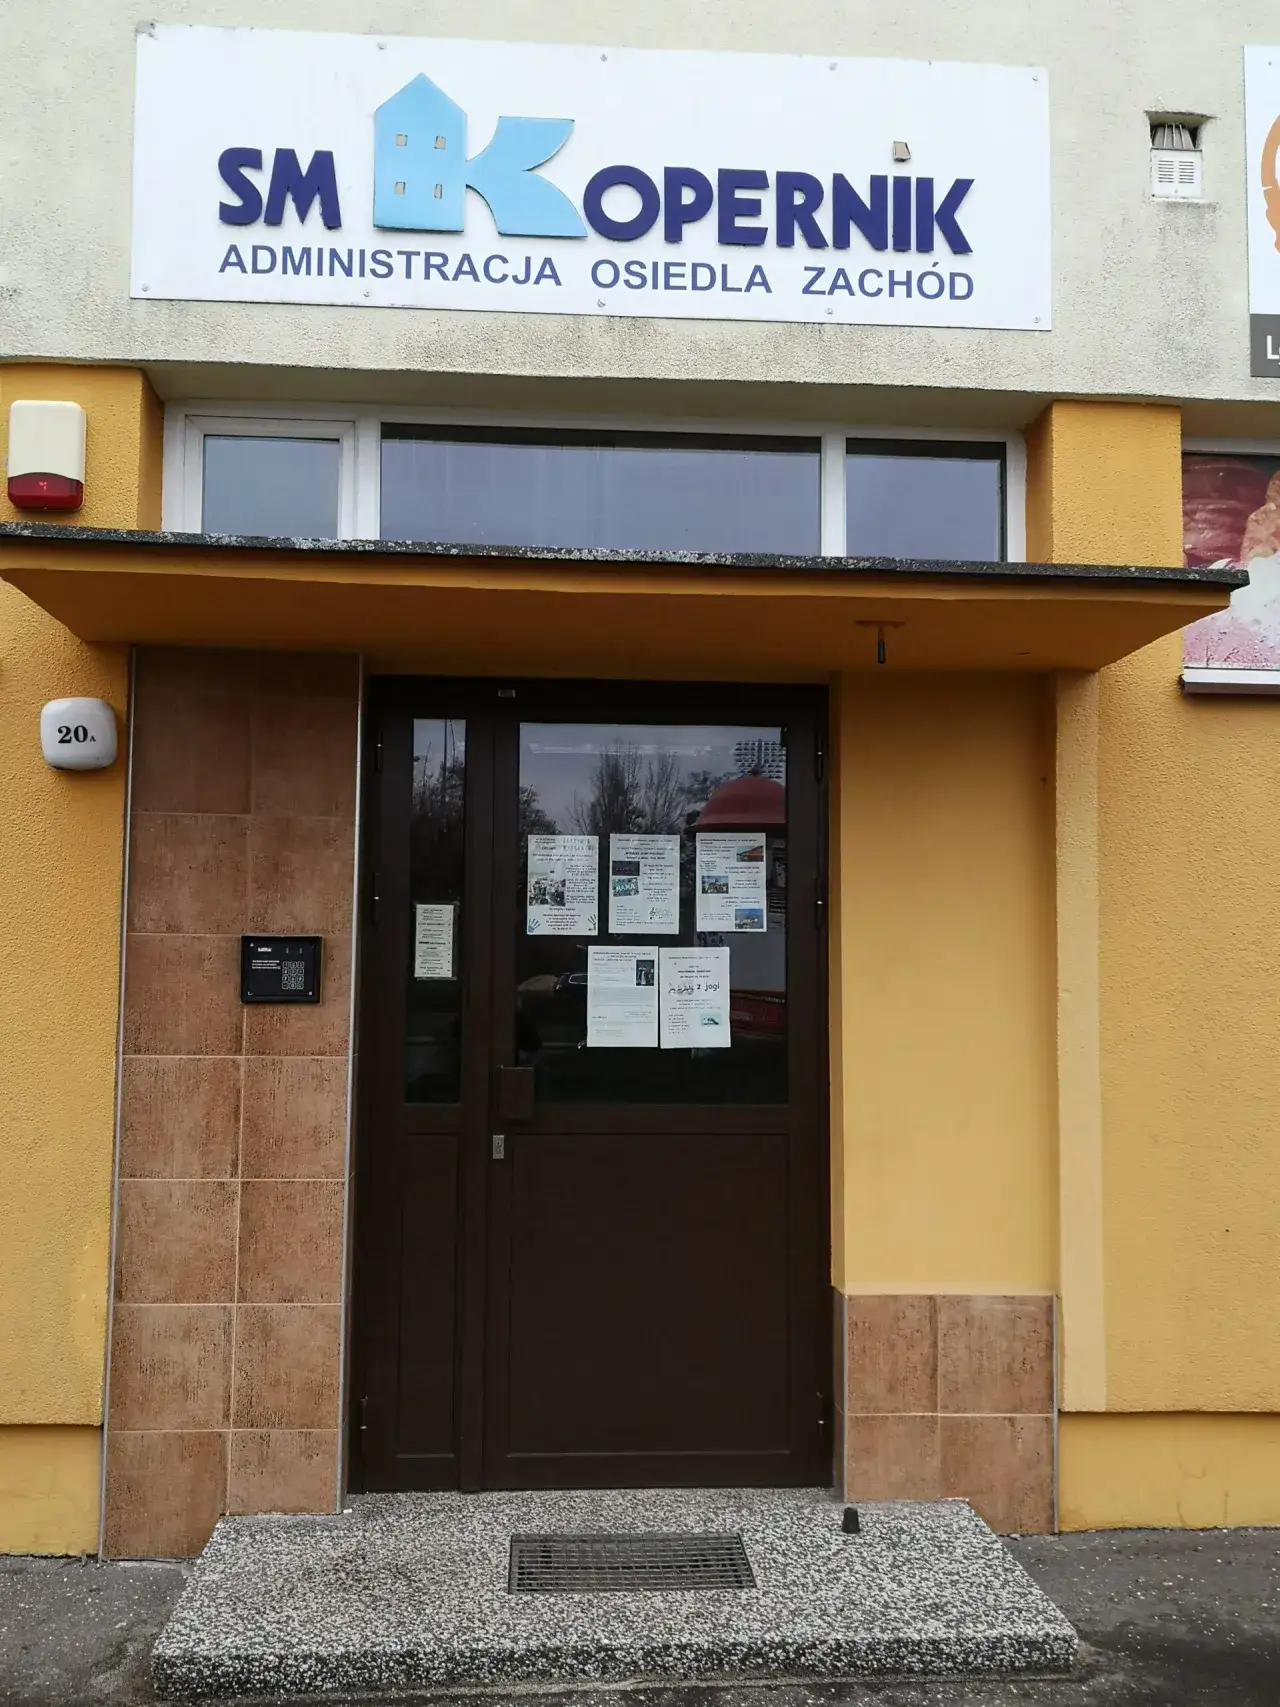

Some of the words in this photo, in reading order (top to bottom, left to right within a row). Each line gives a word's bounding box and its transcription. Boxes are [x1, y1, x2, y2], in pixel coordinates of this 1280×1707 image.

[218, 147, 342, 229] SM
[218, 244, 562, 287] ADMINISTRACJA
[591, 259, 773, 294] OSIEDLA
[802, 262, 975, 301] ZACHÓD
[704, 982, 720, 992] jogi
